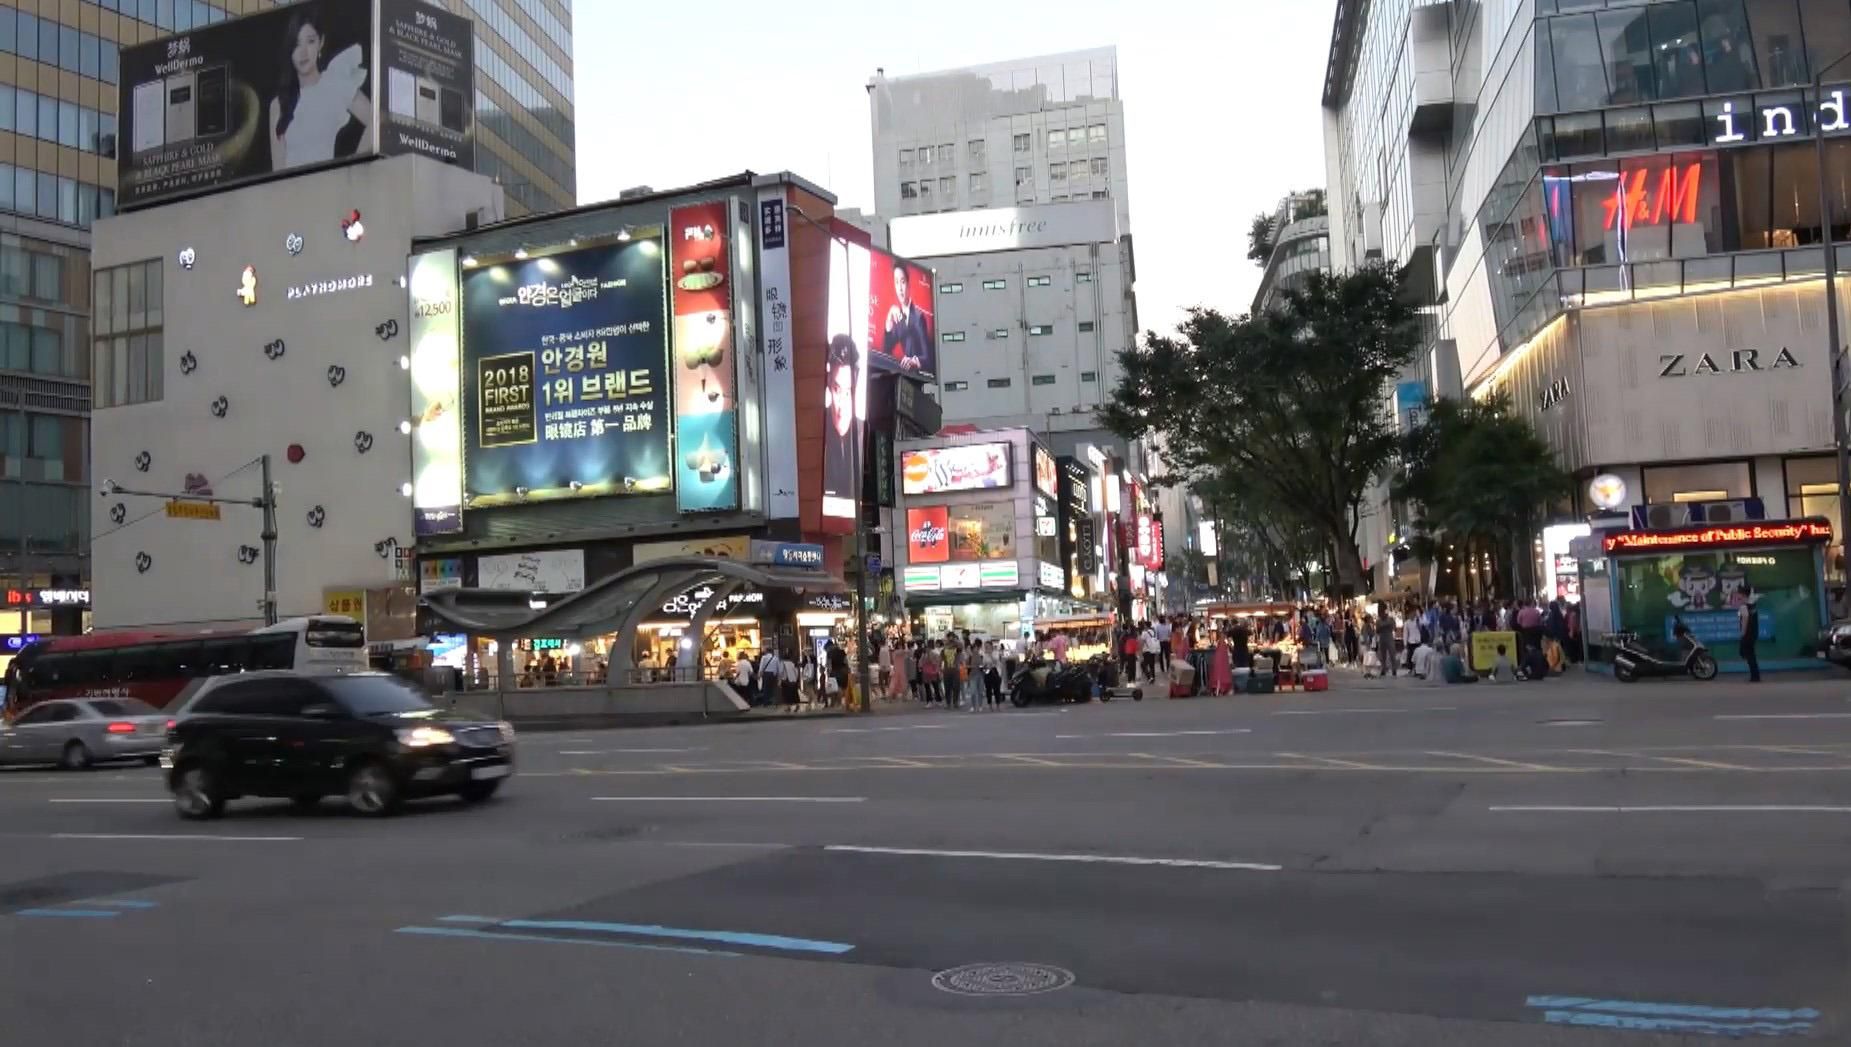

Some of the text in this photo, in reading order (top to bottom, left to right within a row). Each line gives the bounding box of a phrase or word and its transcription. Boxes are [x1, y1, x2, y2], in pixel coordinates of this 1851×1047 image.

[1601, 163, 1701, 230] H&M
[684, 224, 713, 240] FILA
[959, 217, 1047, 238] innisfree
[541, 340, 607, 374] 안경원
[1658, 346, 1804, 378] ZARA
[485, 365, 529, 388] 2018
[542, 368, 653, 407] 1위 브랜드
[485, 385, 530, 406] FIRST
[1539, 375, 1570, 412] ZARA
[545, 419, 587, 441] 眼镜店
[590, 417, 620, 436] 第一
[622, 412, 653, 433] 品牌
[911, 526, 945, 544] Coca-Cola
[1700, 530, 1715, 543] of
[1715, 528, 1752, 541] Public
